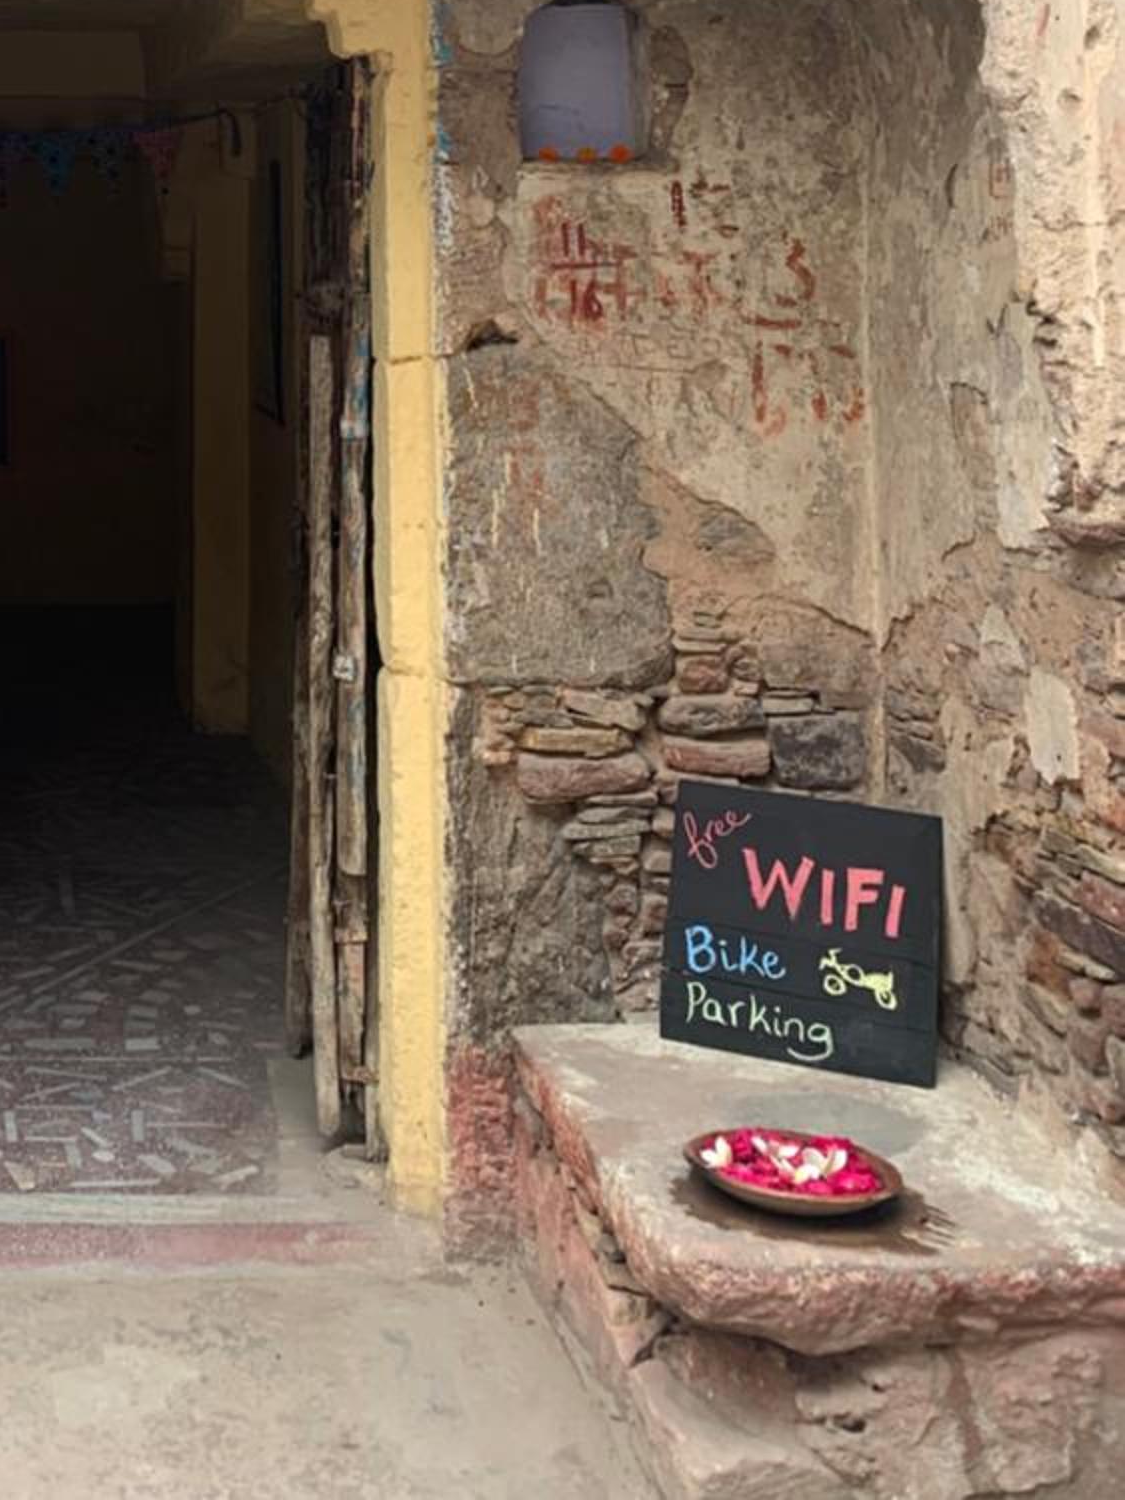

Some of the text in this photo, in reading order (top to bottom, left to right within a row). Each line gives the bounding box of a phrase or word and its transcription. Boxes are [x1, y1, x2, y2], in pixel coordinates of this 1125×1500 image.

[741, 847, 907, 939] WIFI
[684, 924, 787, 981] Bike
[685, 980, 835, 1063] Parking
